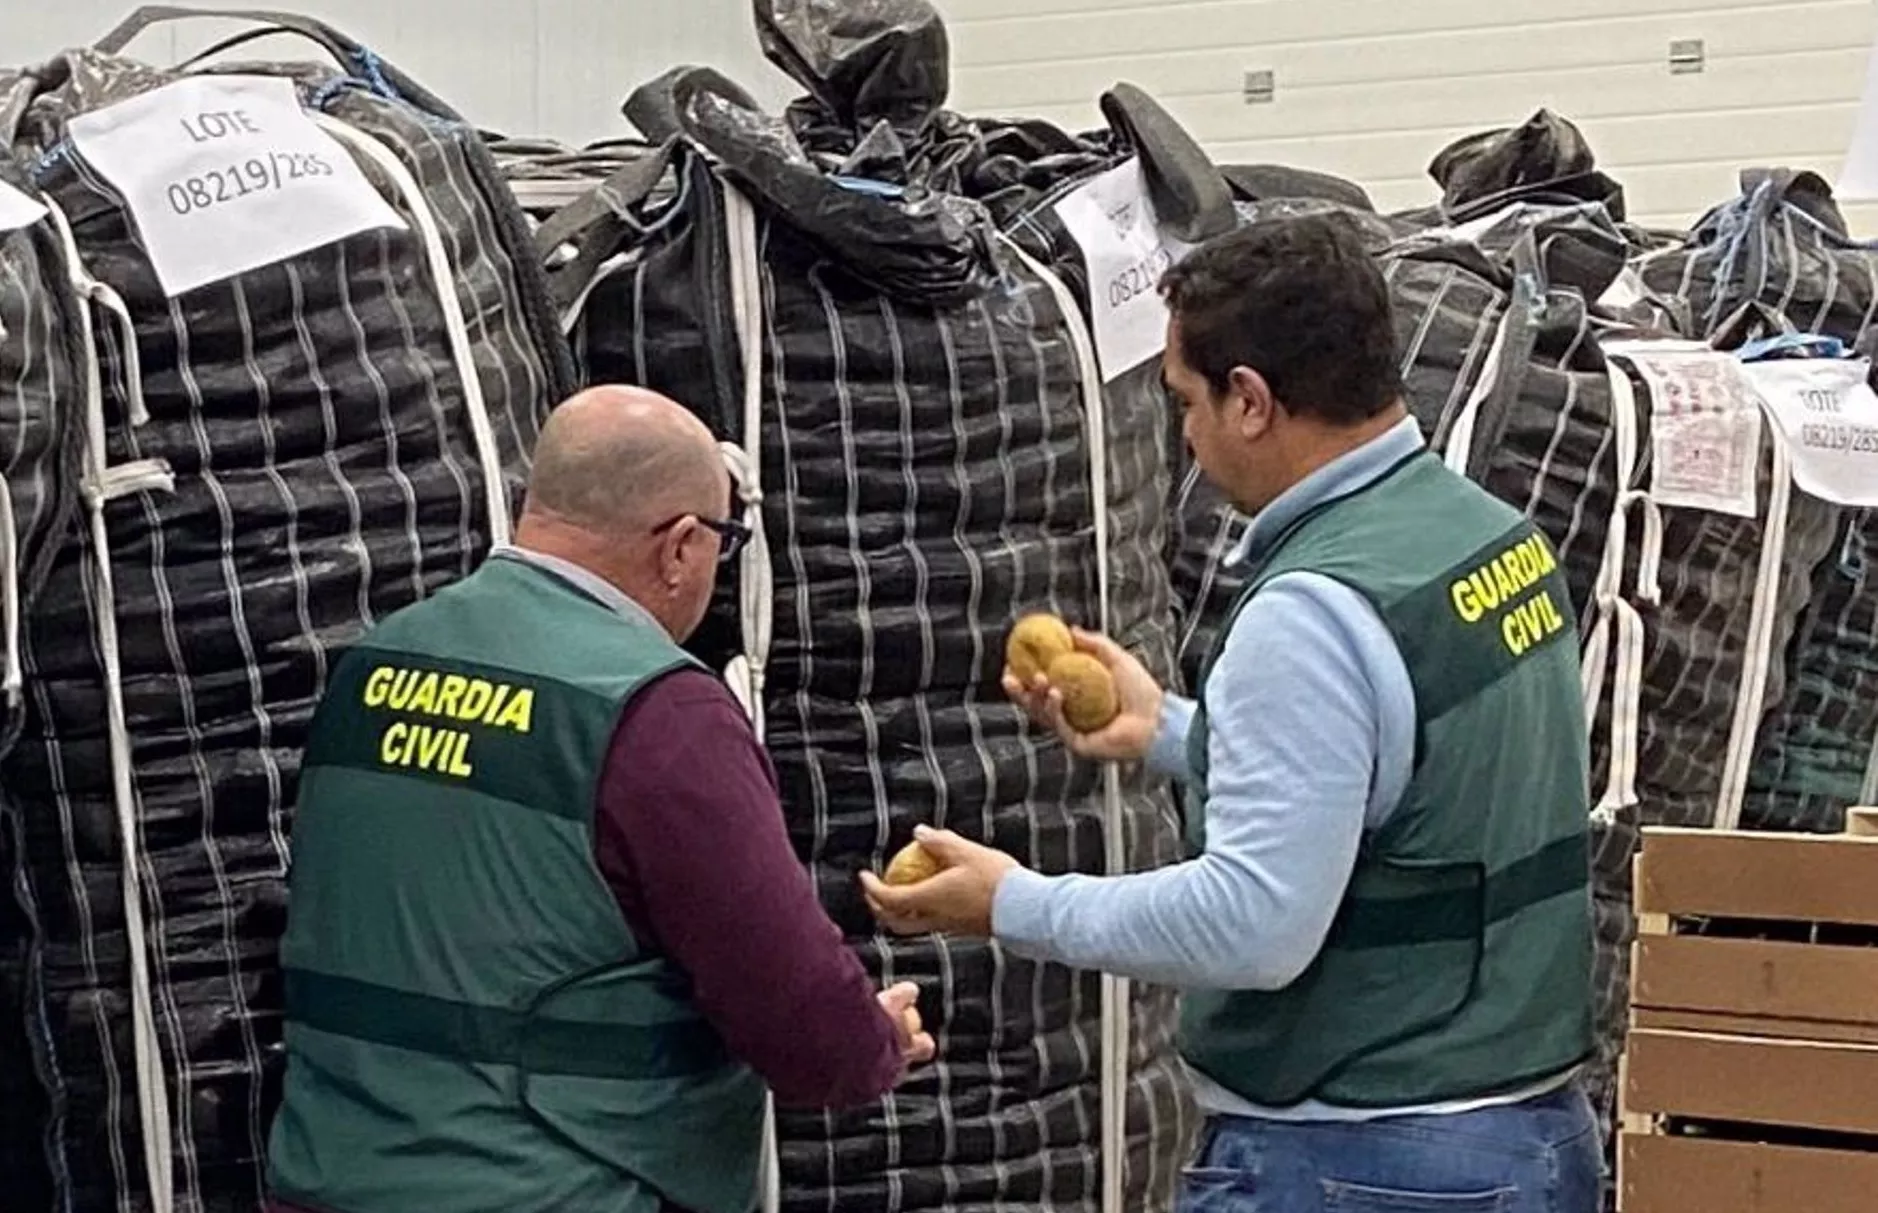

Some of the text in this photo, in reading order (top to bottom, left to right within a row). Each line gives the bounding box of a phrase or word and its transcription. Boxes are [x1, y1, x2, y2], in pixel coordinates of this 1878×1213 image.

[180, 110, 261, 143] LOTE
[1451, 532, 1557, 622] GUARDIA
[1502, 591, 1563, 656] CIVIL
[364, 666, 534, 732] GUARDIA
[381, 722, 473, 777] CIVIL
